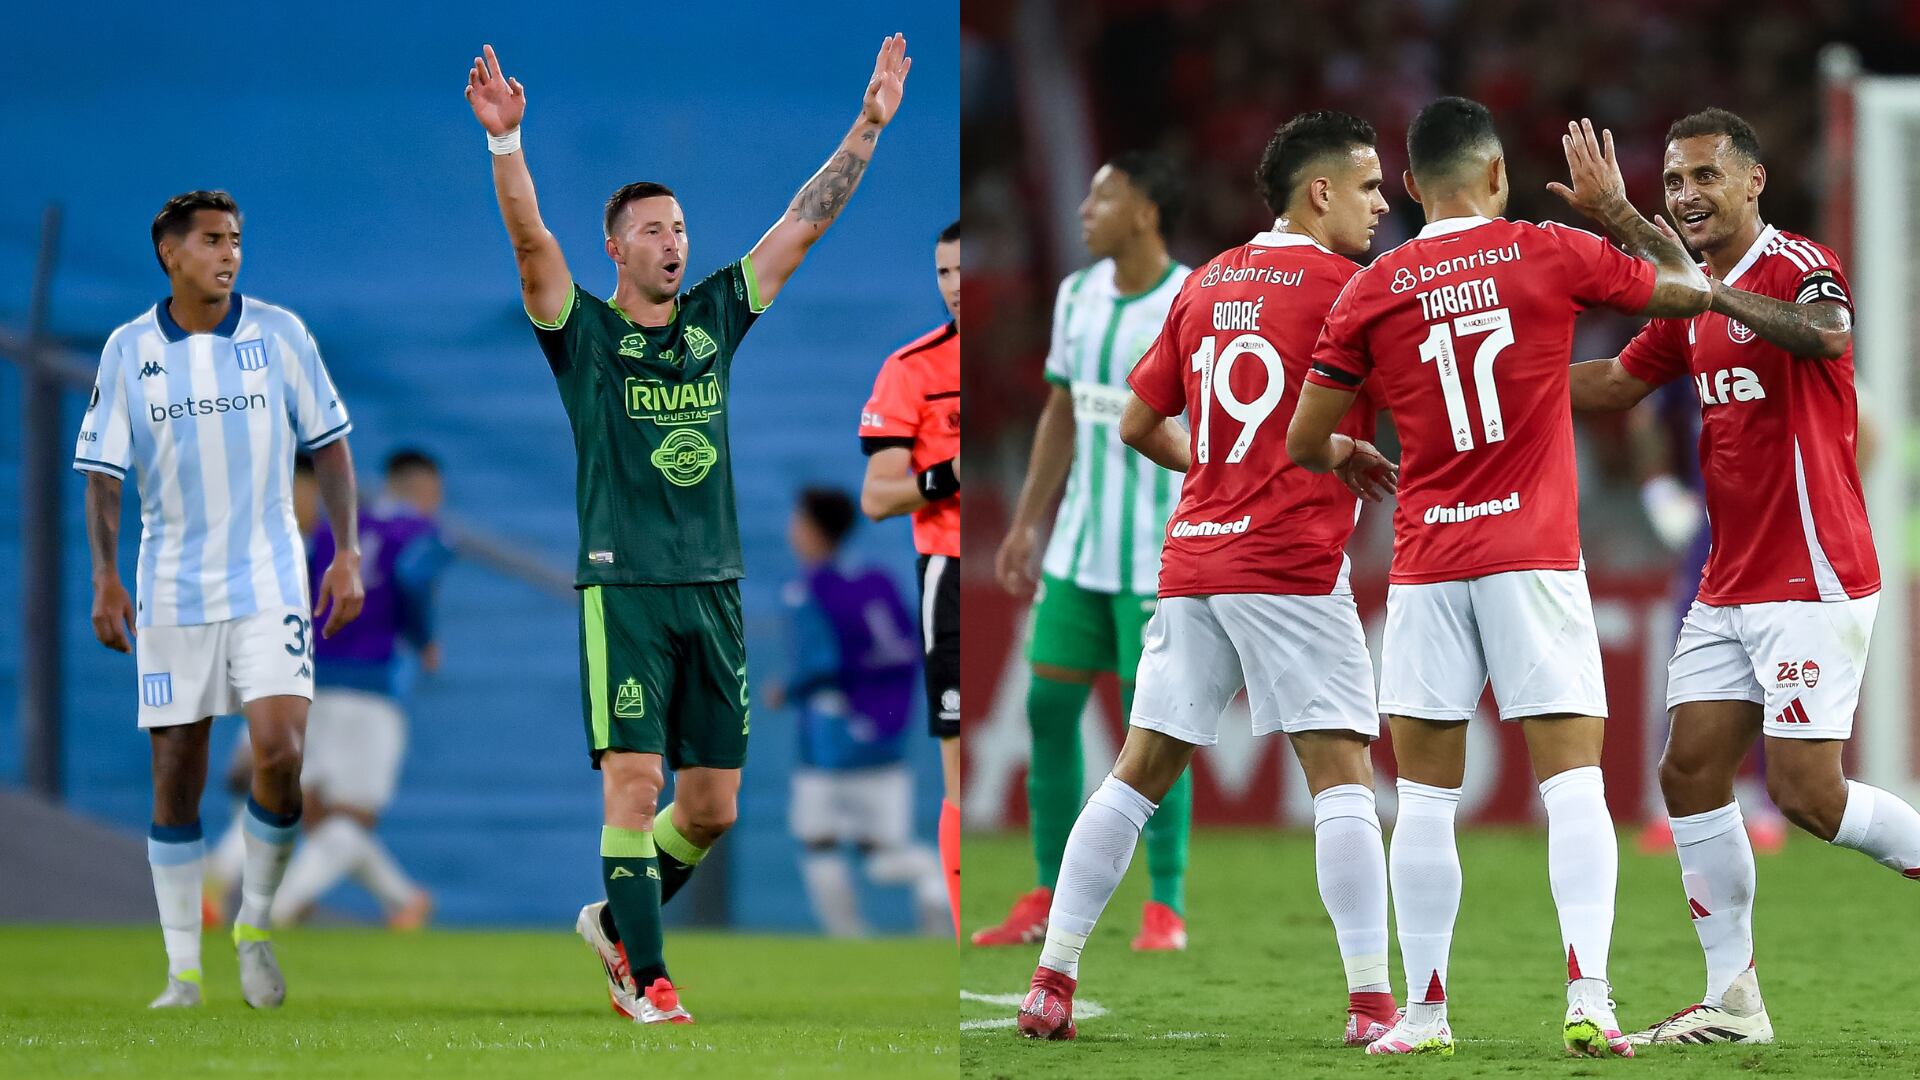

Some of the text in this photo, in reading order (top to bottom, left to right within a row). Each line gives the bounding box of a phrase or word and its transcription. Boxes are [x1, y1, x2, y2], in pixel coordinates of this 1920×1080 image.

[1221, 265, 1305, 287] banrisul
[1420, 242, 1521, 283] banrisul
[1212, 295, 1264, 331] BORRÉ
[1416, 276, 1500, 321] TABATA
[631, 381, 718, 411] RIVALO
[1418, 307, 1516, 452] 17
[1694, 367, 1766, 408] lfa
[150, 394, 266, 422] betsson
[658, 410, 708, 422] APUESTAS
[1191, 333, 1286, 464] 19
[1423, 491, 1521, 525] Unimed
[1776, 661, 1800, 682] Zé
